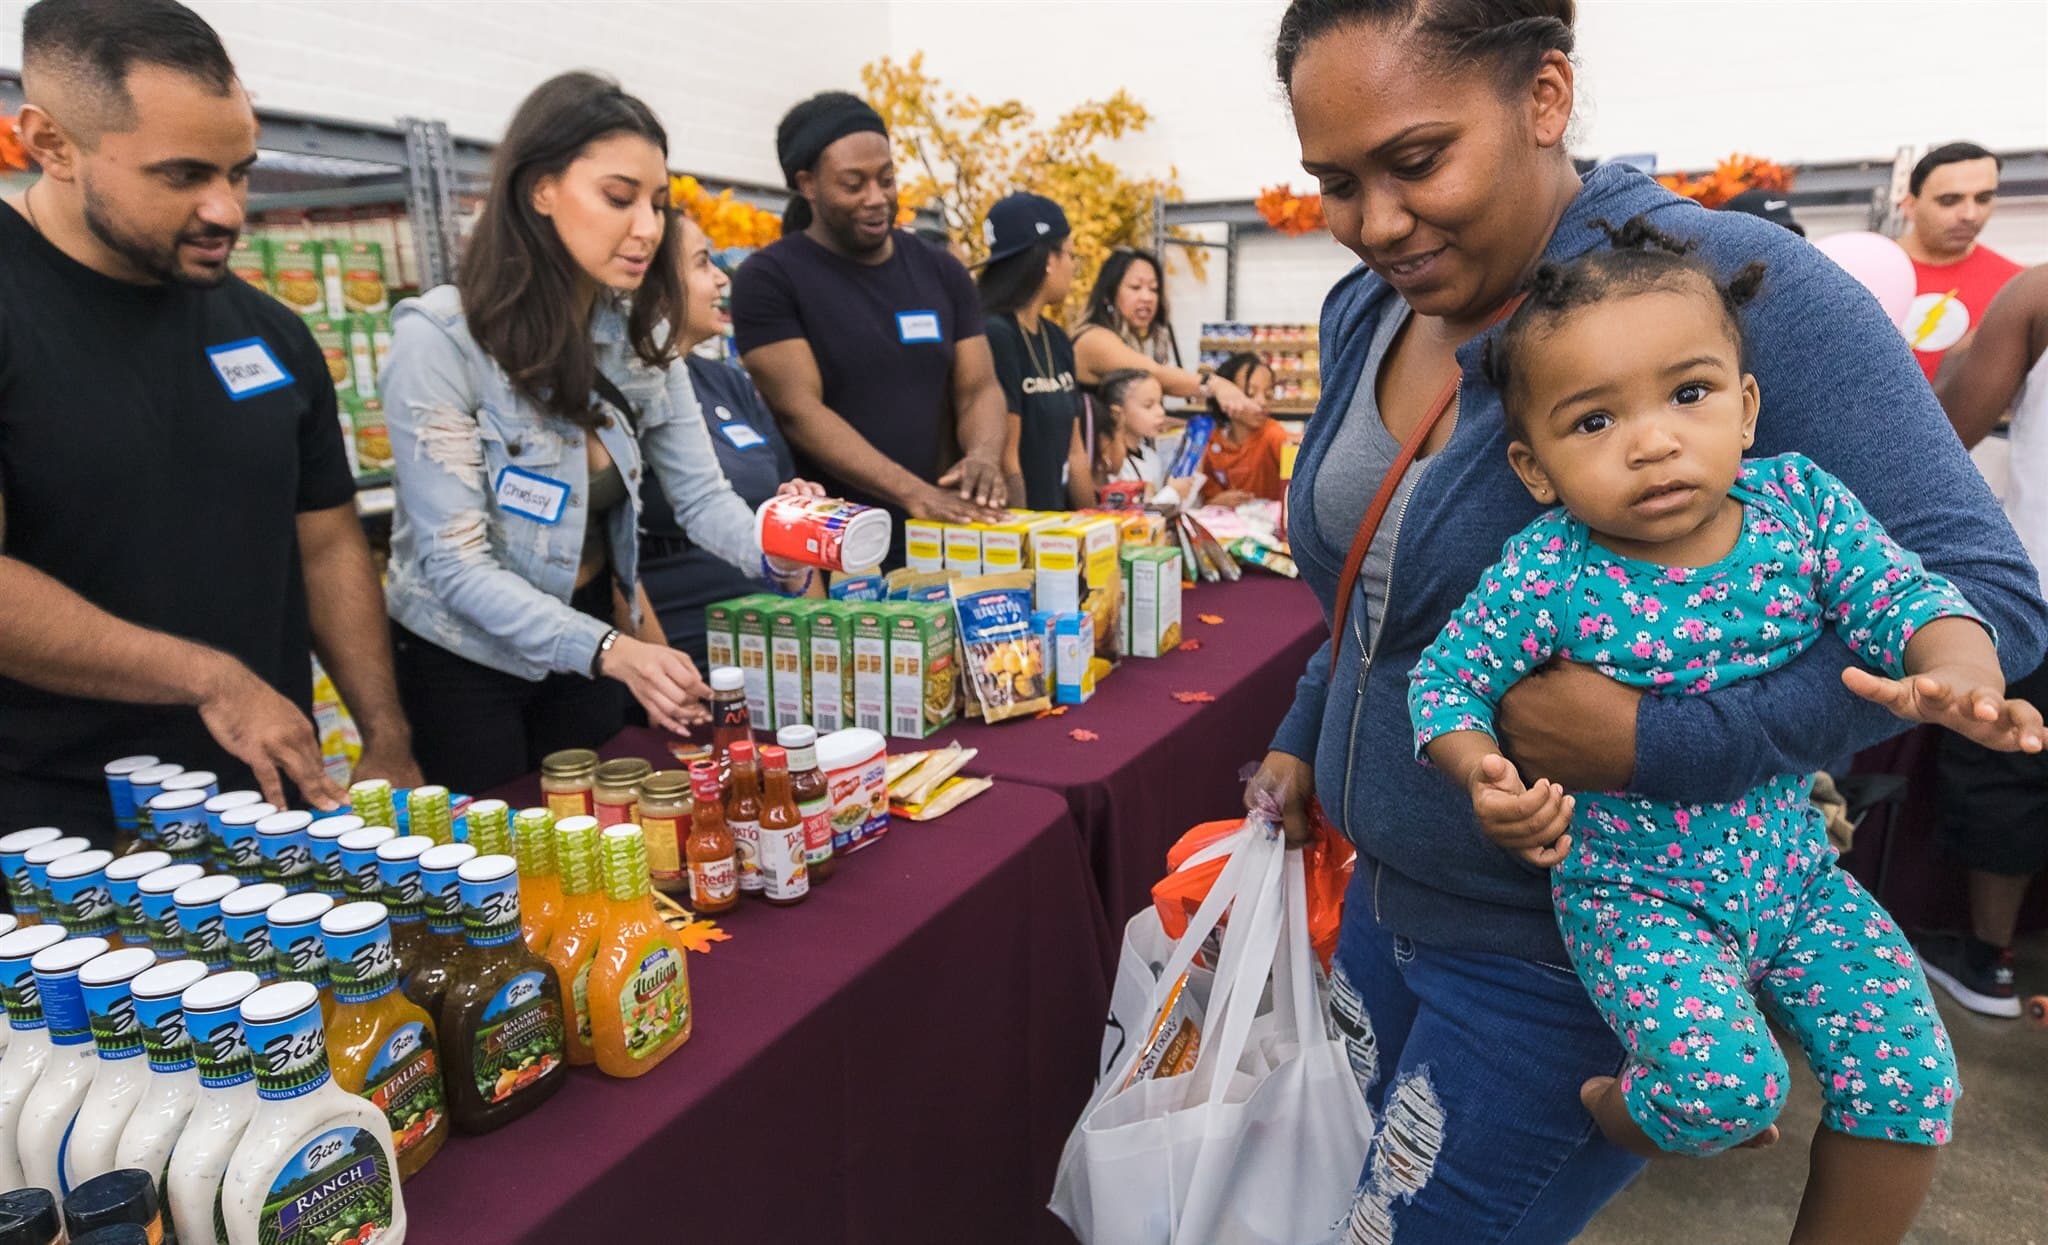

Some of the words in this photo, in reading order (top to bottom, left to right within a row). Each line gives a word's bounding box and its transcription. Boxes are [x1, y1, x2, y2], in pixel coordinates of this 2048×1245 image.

[276, 845, 311, 874] Zi
[73, 887, 112, 918] Zi
[482, 891, 519, 924] Zit
[289, 936, 325, 970] Zi
[351, 938, 391, 979] Zit
[633, 961, 676, 994] Italian
[510, 983, 533, 1005] Zito
[496, 1011, 549, 1043] VINAIGRETTE
[504, 1007, 541, 1031] BALSAMIC
[103, 1049, 141, 1058] PREMIUM
[208, 1021, 246, 1062] Zi
[264, 1027, 325, 1073] Zito
[391, 1034, 414, 1059] Zito
[152, 1063, 188, 1072] PREMIUM
[204, 1076, 241, 1086] PREMIUM
[383, 1057, 427, 1099] ITALIAN
[260, 1090, 296, 1099] PREMIUM
[298, 1078, 322, 1096] SALAD
[308, 1139, 343, 1170] Zito
[295, 1165, 362, 1214] RANCH
[308, 1189, 364, 1225] DRESSING
